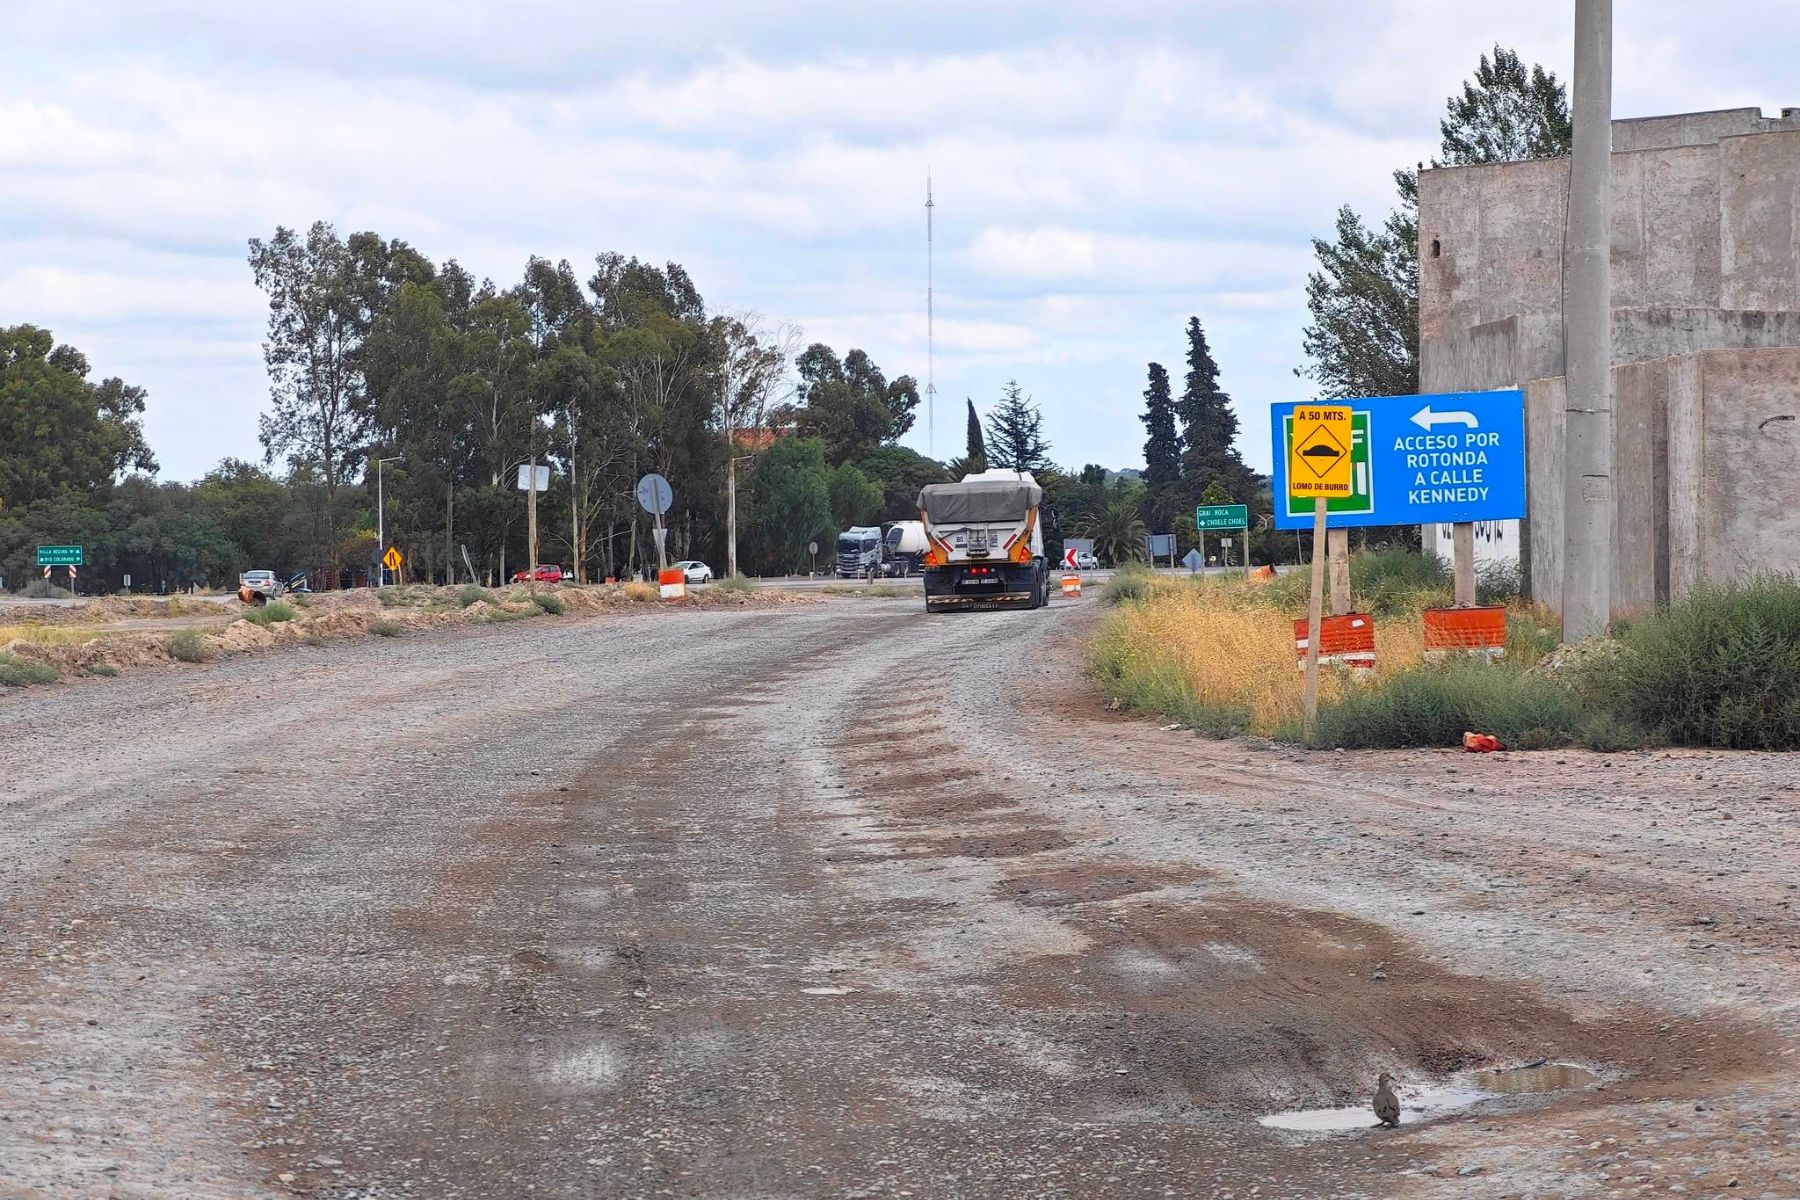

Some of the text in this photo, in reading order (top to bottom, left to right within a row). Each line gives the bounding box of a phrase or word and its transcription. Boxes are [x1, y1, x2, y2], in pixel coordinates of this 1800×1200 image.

[1299, 411, 1346, 421] A 50 MTS.
[1393, 432, 1500, 451] ACCESO POR
[1407, 451, 1488, 468] ROTONDA
[1414, 468, 1483, 486] A CALLE
[1292, 482, 1312, 490] LOMO
[1324, 483, 1348, 491] BURRO
[1408, 486, 1489, 504] KENNEDY
